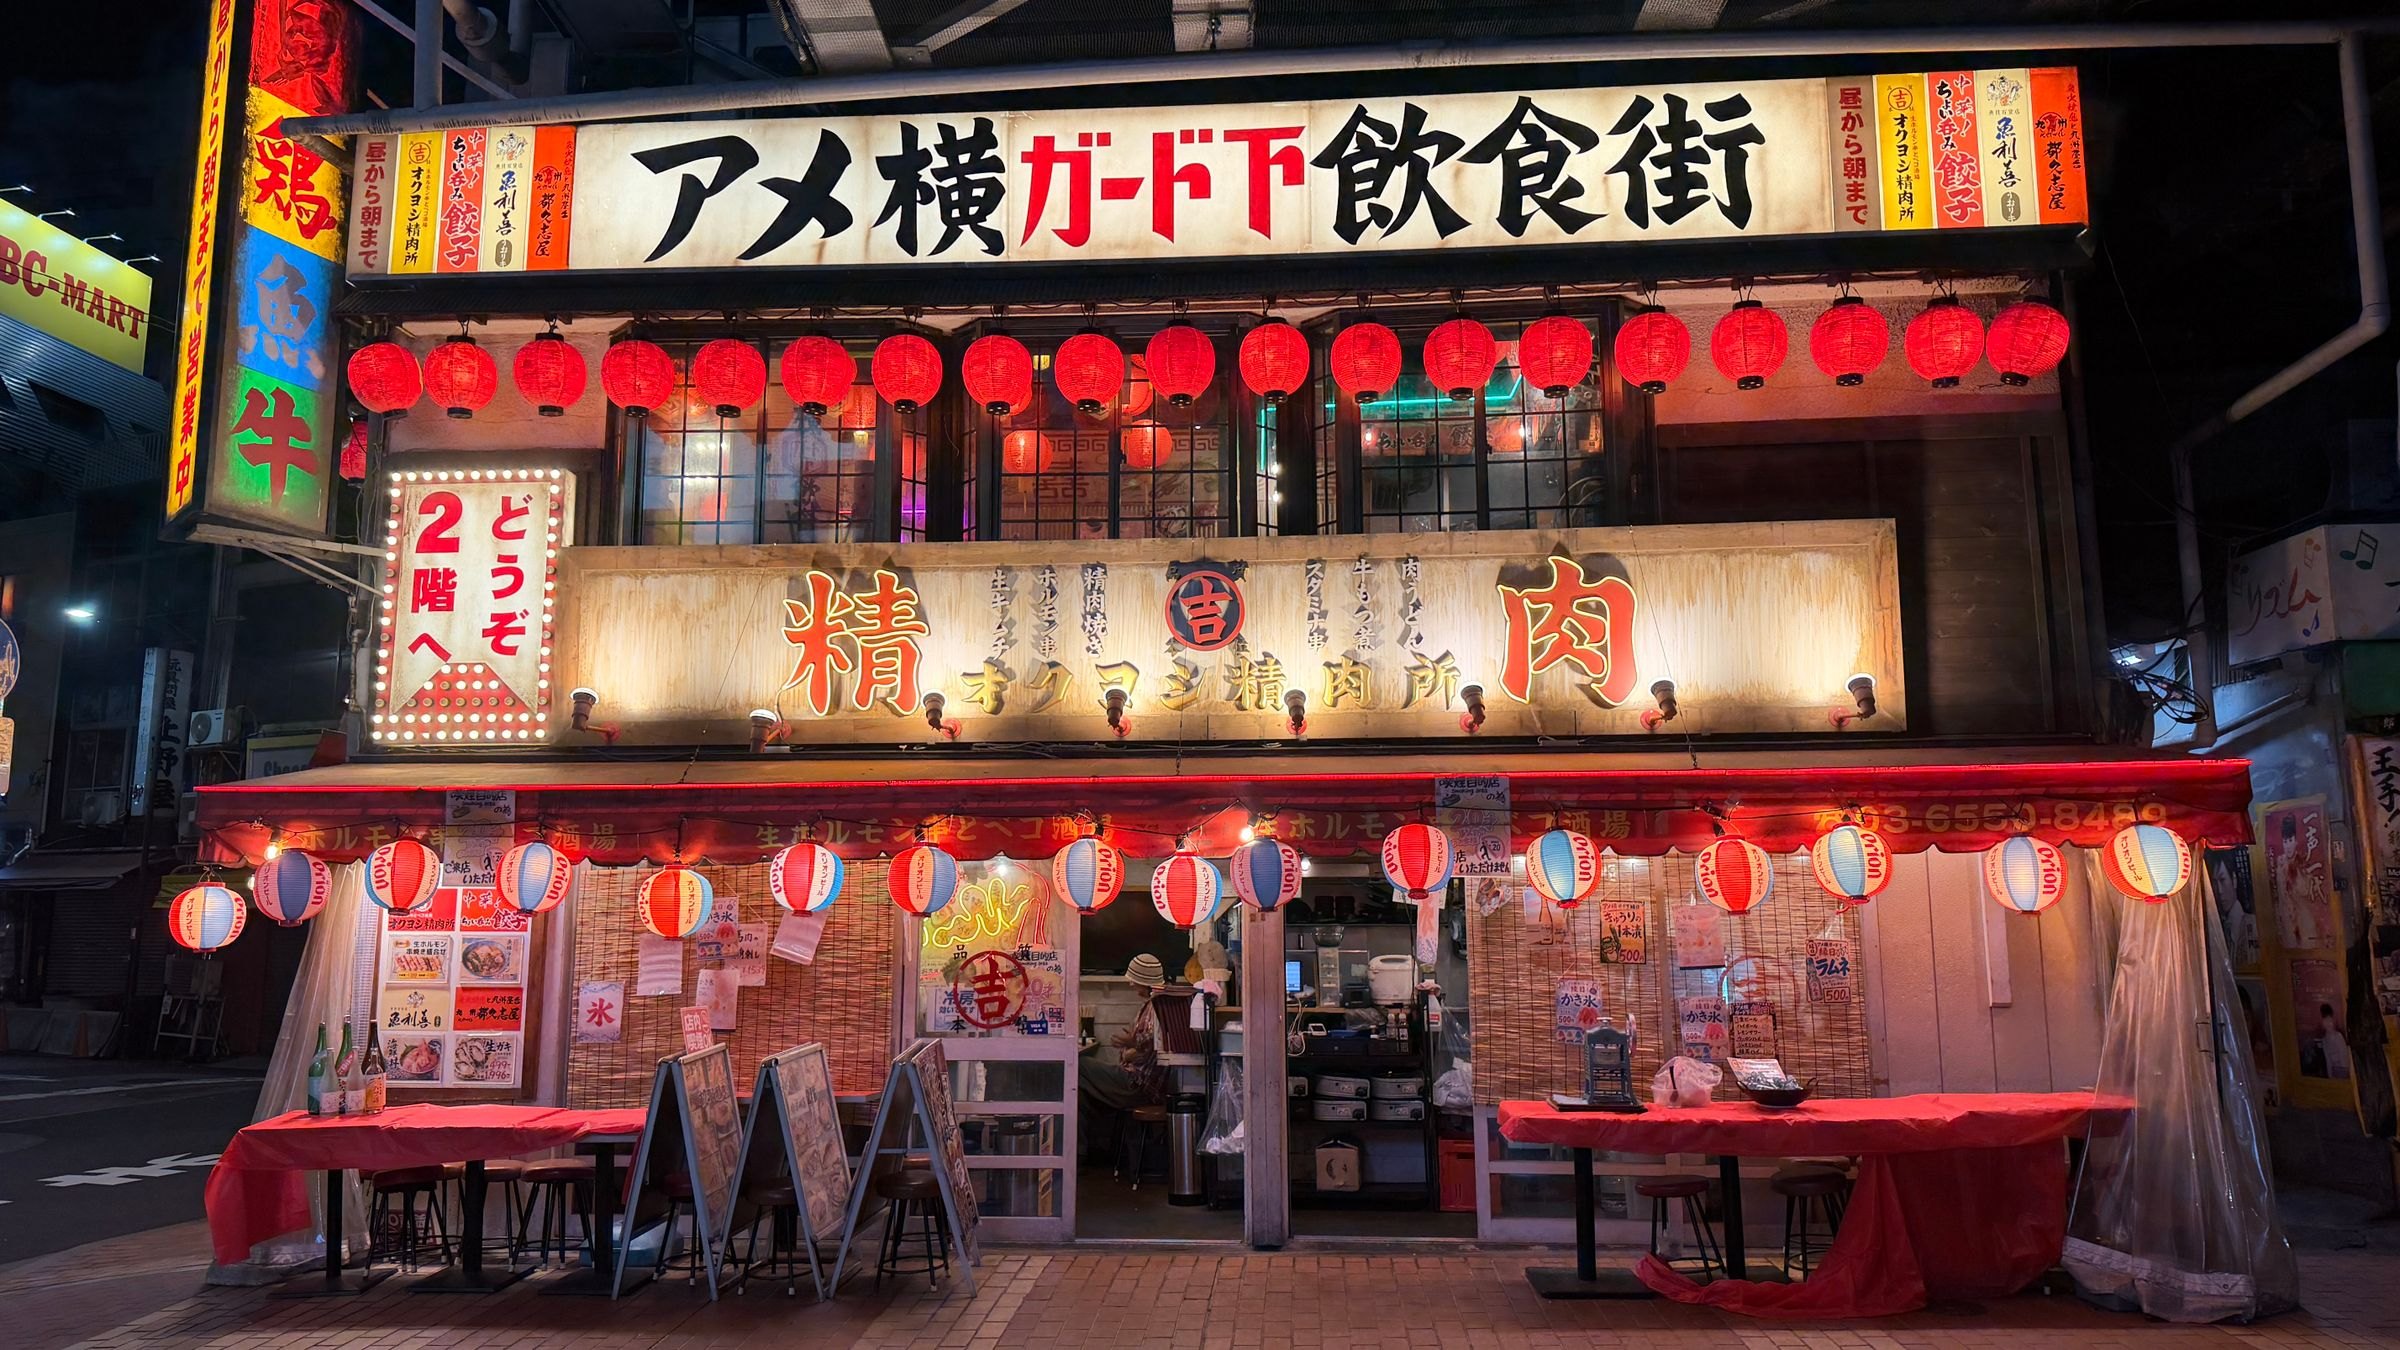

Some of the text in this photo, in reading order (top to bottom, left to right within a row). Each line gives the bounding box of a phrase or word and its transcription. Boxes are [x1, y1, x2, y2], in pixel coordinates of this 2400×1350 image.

[1936, 79, 1958, 150] ちょい呑み
[448, 135, 467, 201] ちょい呑み
[630, 93, 1766, 263] アメ横ガード下飲食街
[1839, 87, 1868, 225] 昼から朝まで
[1893, 113, 1914, 222] オクヨシ精肉所
[1936, 152, 1981, 223] 餃子
[358, 141, 387, 269] 昼から朝まで
[403, 166, 425, 267] オクヨシ精肉所
[441, 201, 480, 268] 餃子
[238, 254, 326, 379] 魚
[231, 386, 319, 508] 牛
[408, 490, 464, 664] 2階へ
[482, 493, 533, 657] どうぞ
[1306, 560, 1327, 651] スタミナ串
[1352, 557, 1375, 651] 牛もつ煮
[1402, 556, 1423, 651] 肉うどん
[781, 568, 931, 717] 精
[991, 568, 1010, 660] 生キムチ
[1039, 568, 1059, 659] ホルモン串
[1084, 566, 1109, 658] 精肉焼き
[1179, 577, 1233, 645] 吉
[1498, 556, 1638, 706] 肉
[961, 650, 1459, 714] オクヨシ精肉所
[311, 861, 326, 906] Orion
[374, 846, 392, 890] Orion
[546, 856, 569, 900] Orion
[816, 852, 828, 897] オリオンビール
[916, 855, 924, 900] オリオンビール
[1097, 848, 1116, 893] Orion
[1152, 865, 1166, 910] Orion
[1281, 848, 1298, 894] Orion
[1573, 836, 1593, 882] Orion
[1699, 851, 1719, 898] Orion
[1860, 833, 1885, 879] Orion
[2037, 846, 2061, 895] Orion
[388, 918, 456, 930] オクヨシ精肉所
[685, 880, 695, 924] オリオンビール
[1603, 911, 1642, 923] きゅうりの
[413, 940, 448, 948] 生ホルモン
[953, 944, 967, 960] 品
[1815, 956, 1850, 976] ラムネ
[586, 997, 616, 1027] 氷
[969, 953, 1020, 1022] 吉
[1560, 993, 1598, 1008] かき氷
[1686, 1010, 1723, 1023] かき氷
[950, 1015, 967, 1034] 本
